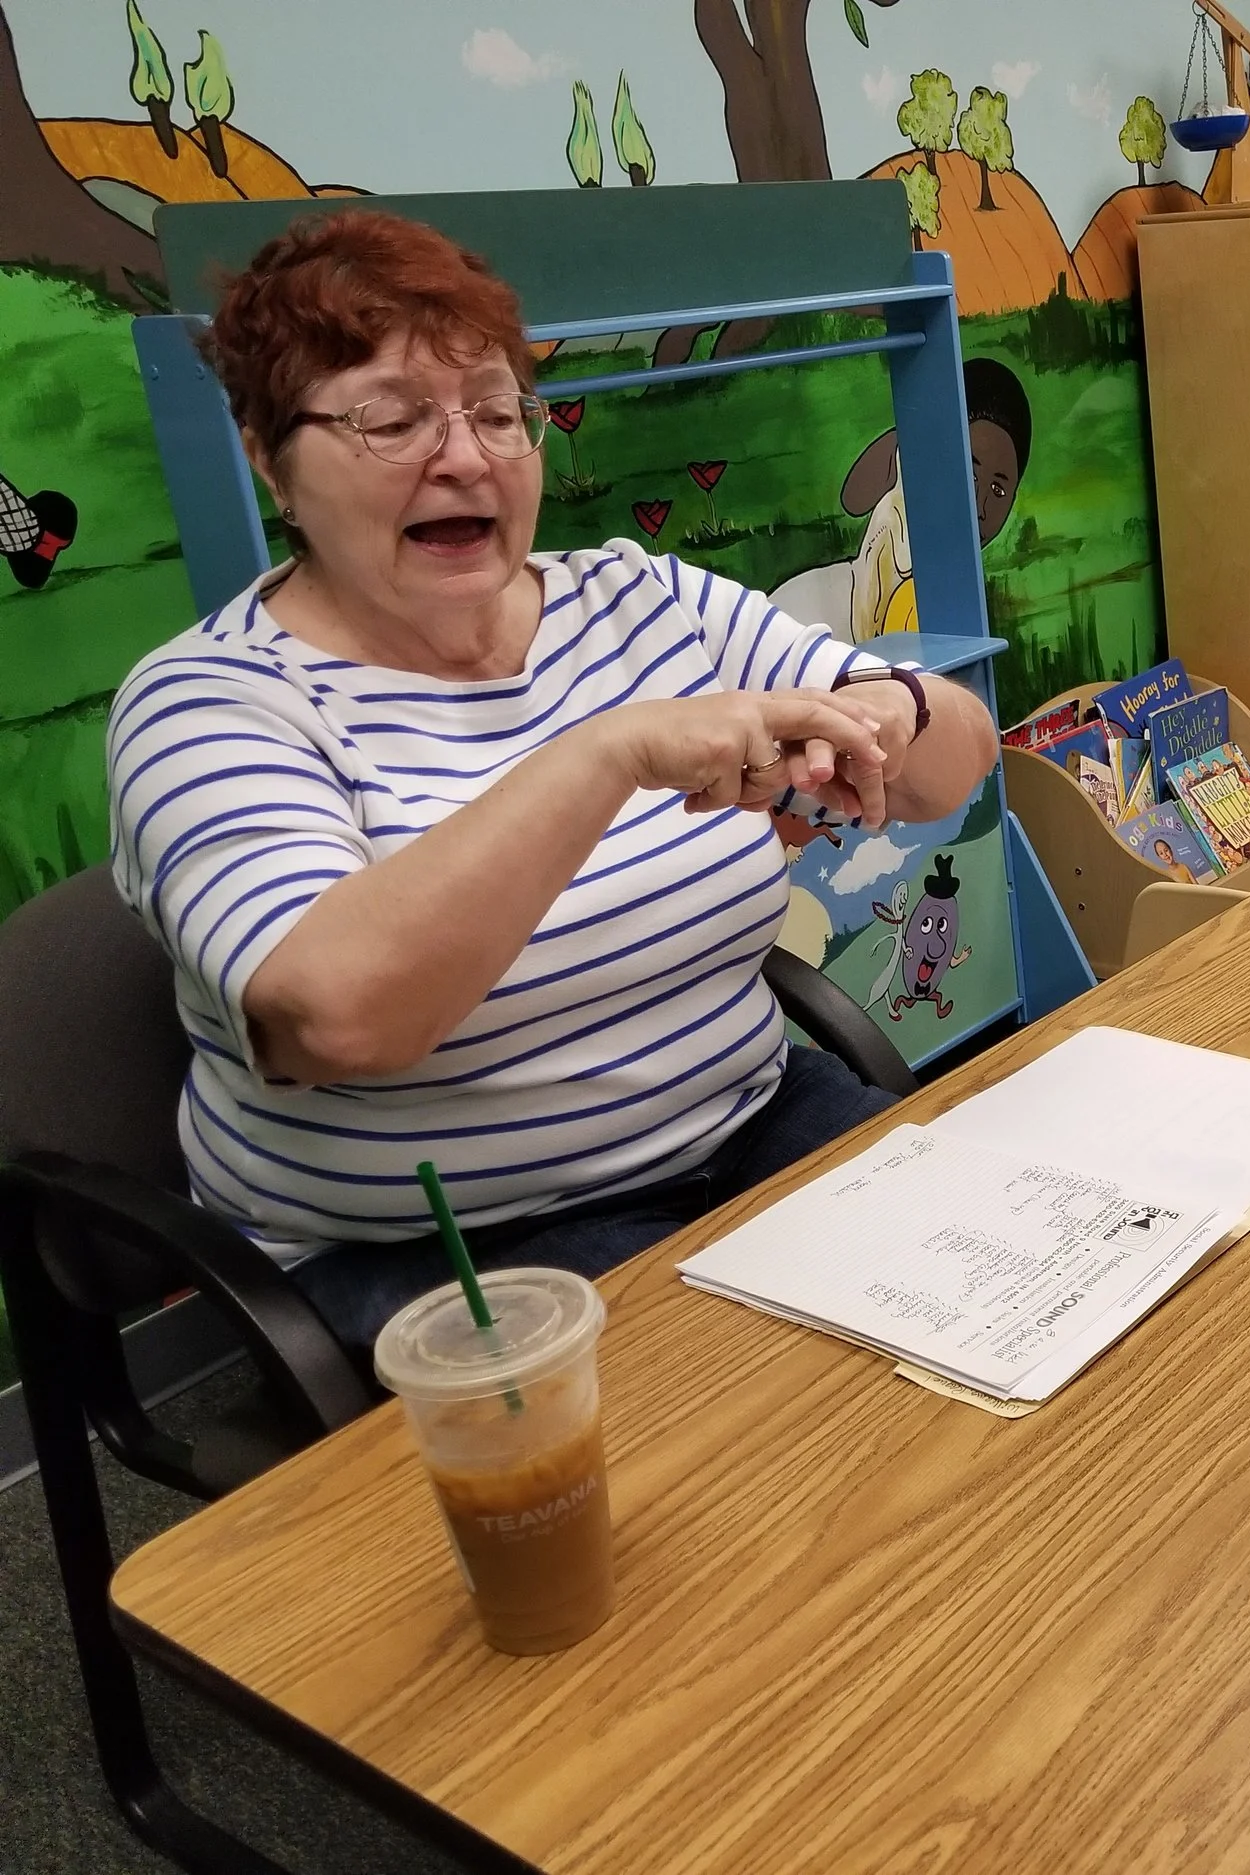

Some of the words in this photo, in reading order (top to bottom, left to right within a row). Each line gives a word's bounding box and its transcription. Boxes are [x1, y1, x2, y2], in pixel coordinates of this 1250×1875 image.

[1120, 680, 1161, 723] Hooray
[1162, 671, 1180, 692] for
[1006, 725, 1032, 747] THE
[1036, 706, 1075, 740] THREE
[1161, 706, 1187, 738] Hey
[1168, 713, 1208, 757] Diddle
[1183, 727, 1223, 761] Diddle
[1192, 769, 1242, 807] NAUGHTY
[1148, 813, 1183, 832] Kids
[1084, 1224, 1101, 1237] Road
[1099, 1211, 1116, 1223] State
[1062, 1242, 1081, 1255] North
[1190, 1228, 1211, 1243] Social
[1076, 1259, 1100, 1279] portable
[1166, 1244, 1192, 1266] Security
[1026, 1261, 1058, 1282] Anderson,
[1079, 1251, 1131, 1291] Professional
[1019, 1278, 1055, 1303] Installation
[1063, 1280, 1076, 1291] and
[1120, 1268, 1166, 1307] Administration
[1029, 1291, 1063, 1316] permanent
[1036, 1292, 1085, 1327] SOUND
[992, 1327, 1040, 1359] Specialist
[476, 1475, 597, 1533] TEAVANA
